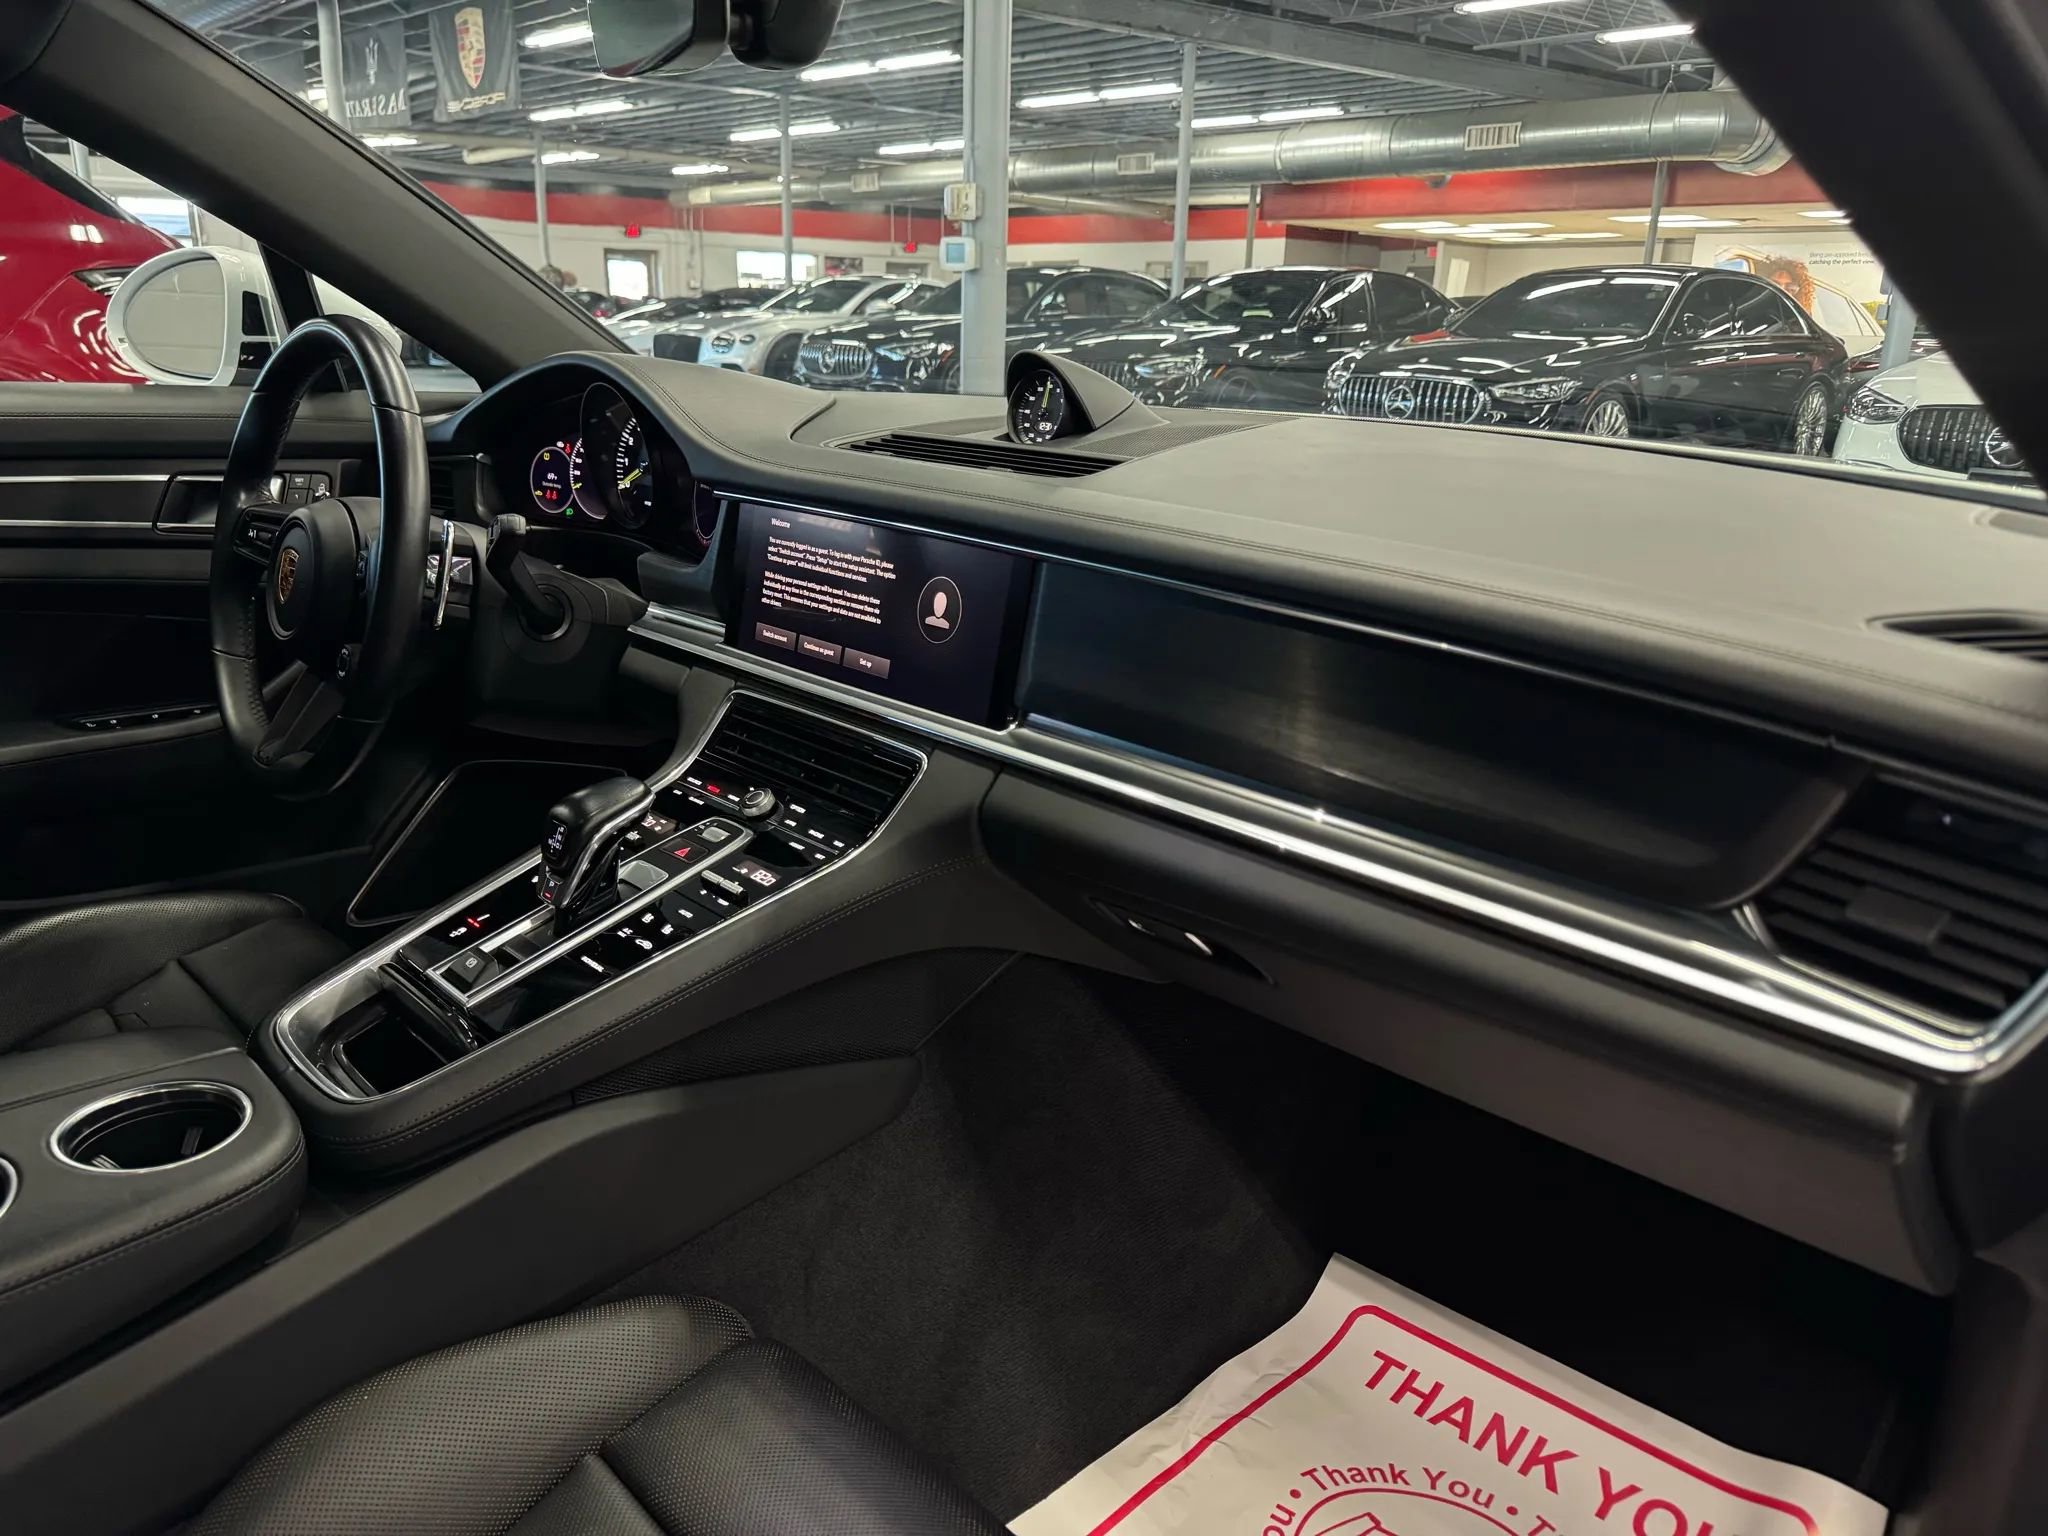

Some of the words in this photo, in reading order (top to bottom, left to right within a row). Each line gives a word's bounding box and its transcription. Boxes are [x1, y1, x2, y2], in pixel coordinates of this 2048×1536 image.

[771, 518, 791, 528] Welcome
[1365, 1349, 1579, 1495] THANK
[1595, 1466, 1714, 1536] YO
[1300, 1463, 1411, 1491] Thank
[1421, 1466, 1495, 1509] You
